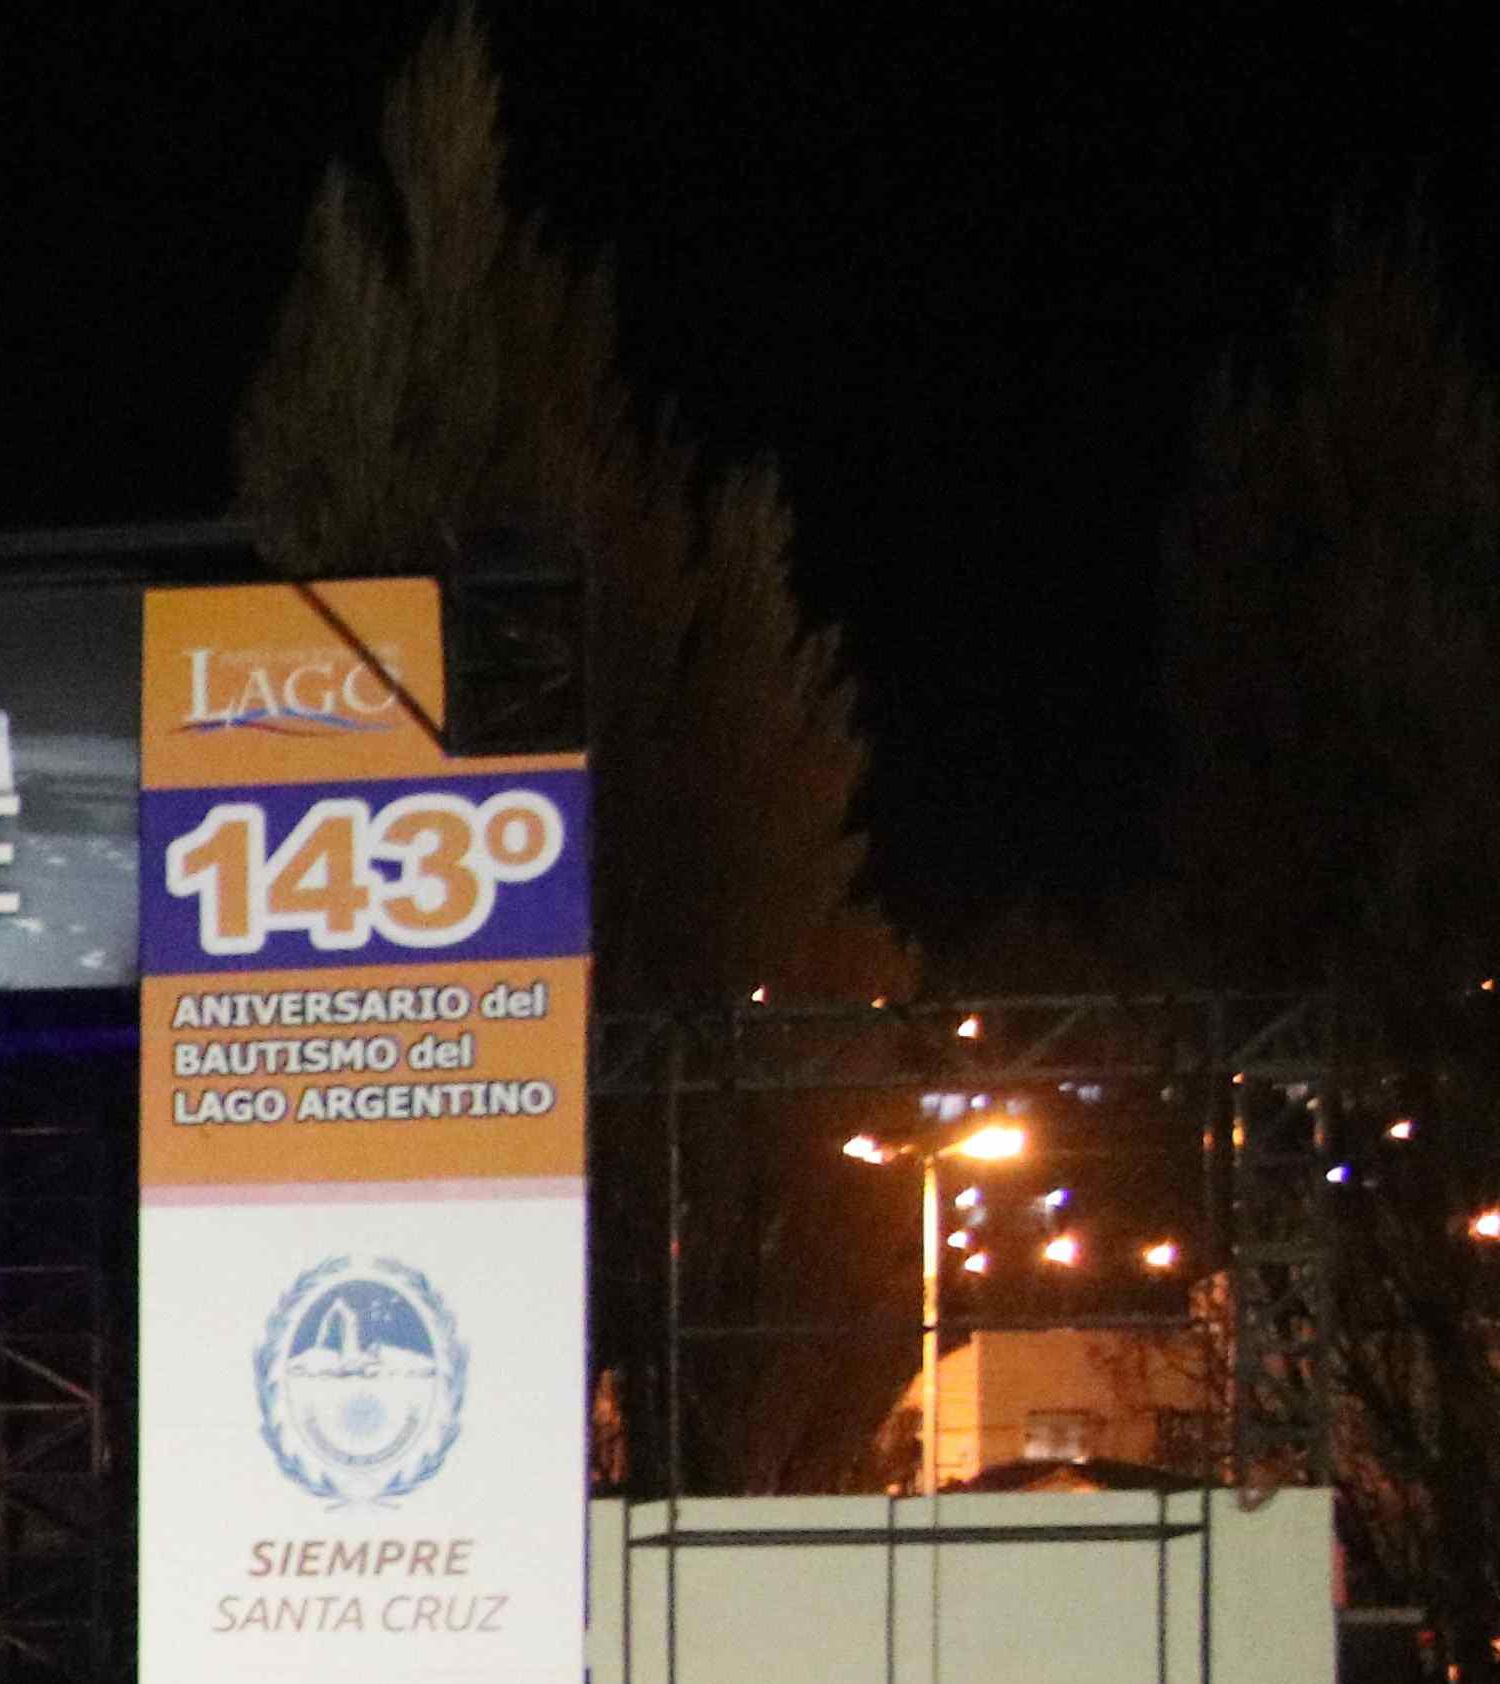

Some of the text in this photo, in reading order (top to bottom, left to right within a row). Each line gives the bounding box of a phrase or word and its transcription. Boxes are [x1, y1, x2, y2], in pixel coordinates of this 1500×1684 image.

[171, 982, 547, 1029] ANIVERSARIO del
[174, 1033, 474, 1076] BAUTISMO del
[174, 1080, 555, 1125] LAGO ARGENTINO
[248, 1538, 475, 1576] SIEMPRE
[212, 1594, 509, 1633] SANTA CRUZ
